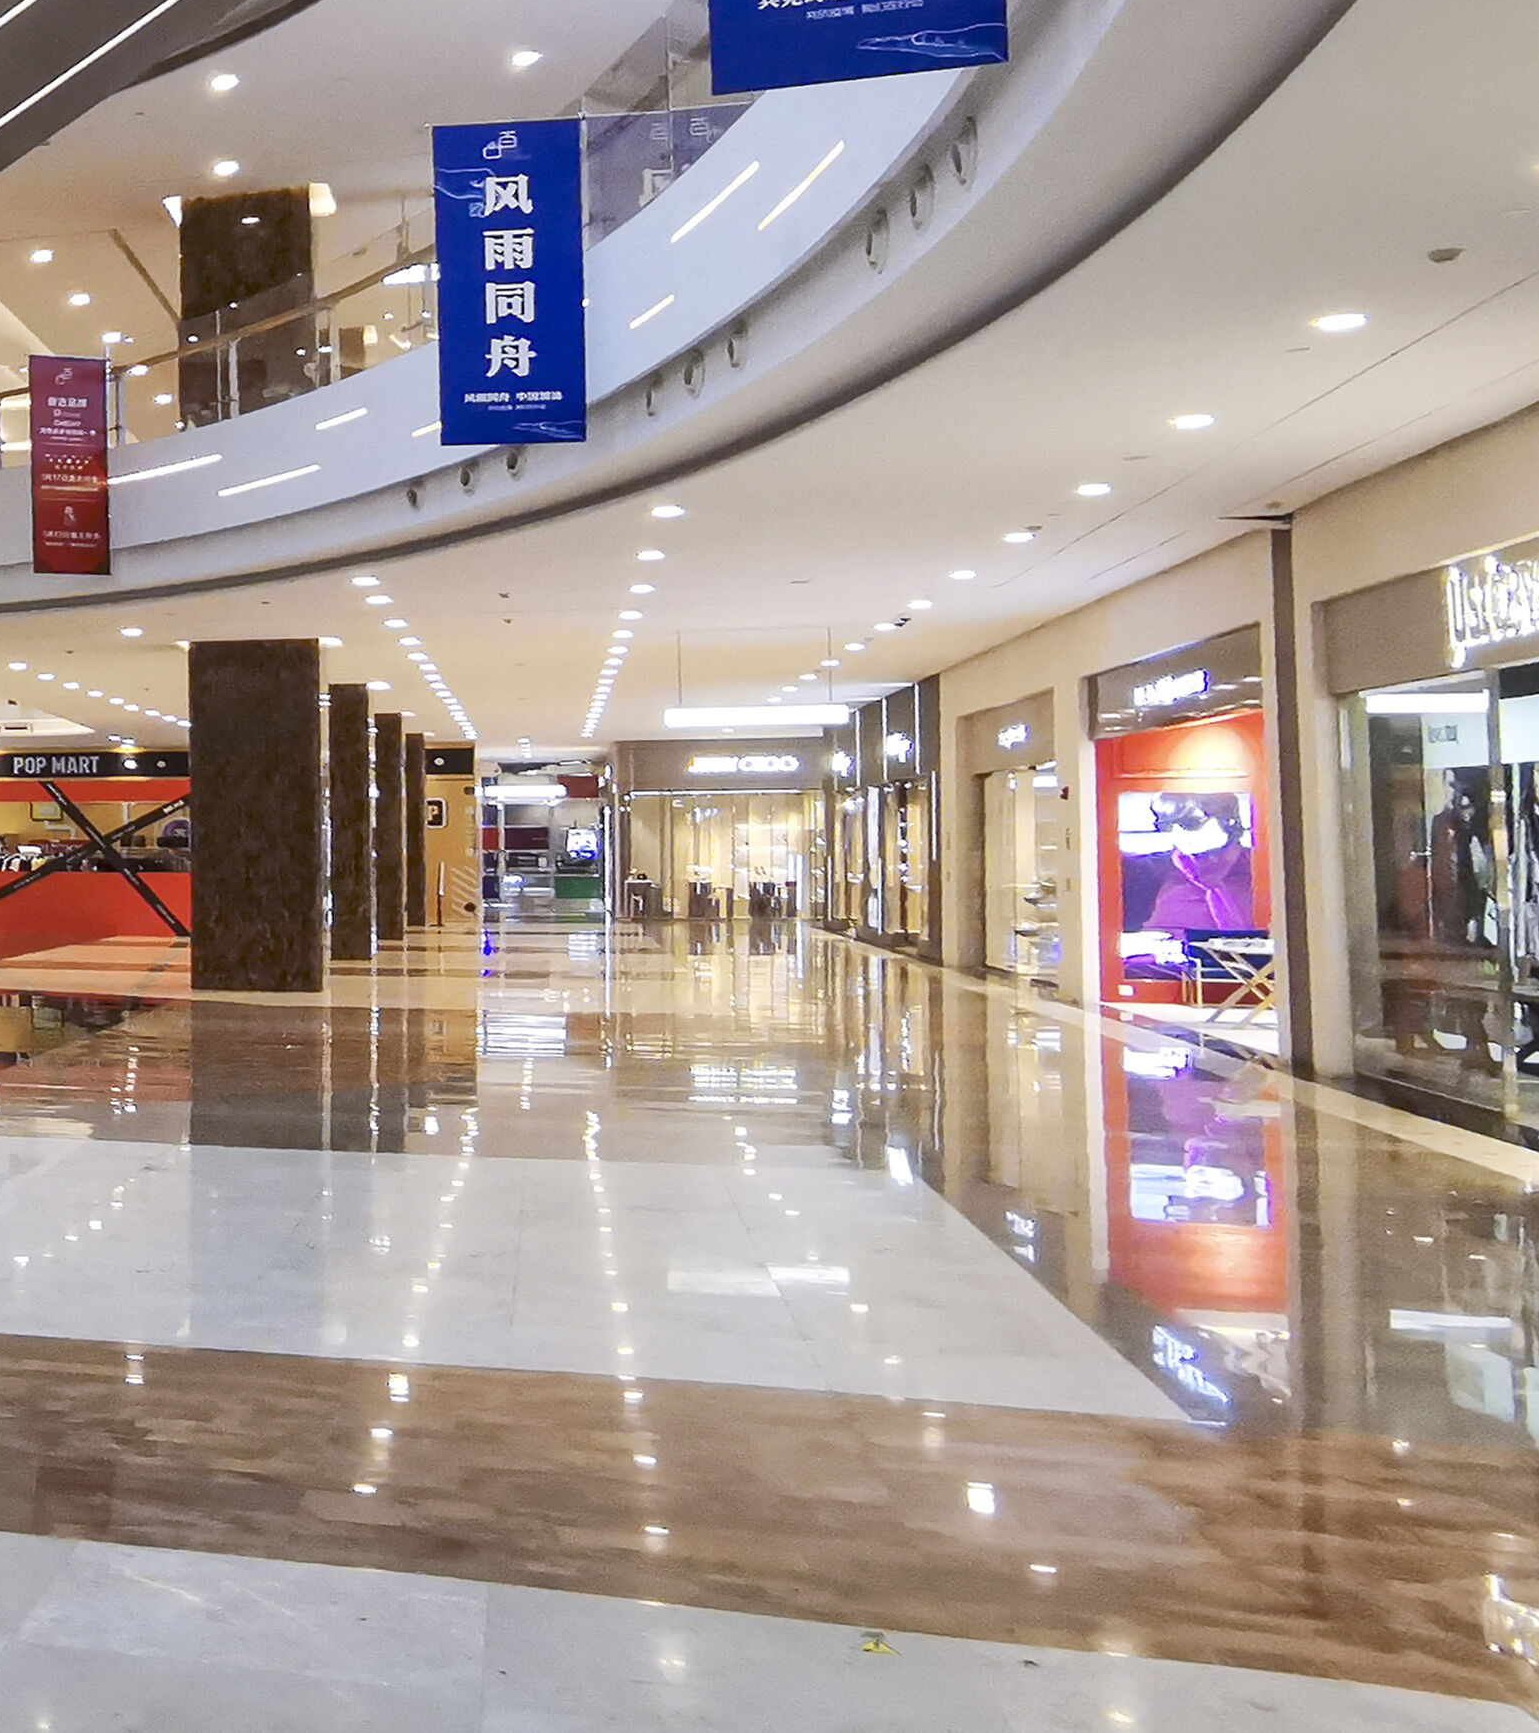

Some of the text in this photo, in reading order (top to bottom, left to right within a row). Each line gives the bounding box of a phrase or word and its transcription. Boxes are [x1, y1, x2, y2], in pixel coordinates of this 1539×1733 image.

[482, 174, 538, 378] 风雨同舟
[13, 755, 100, 774] POP MART
